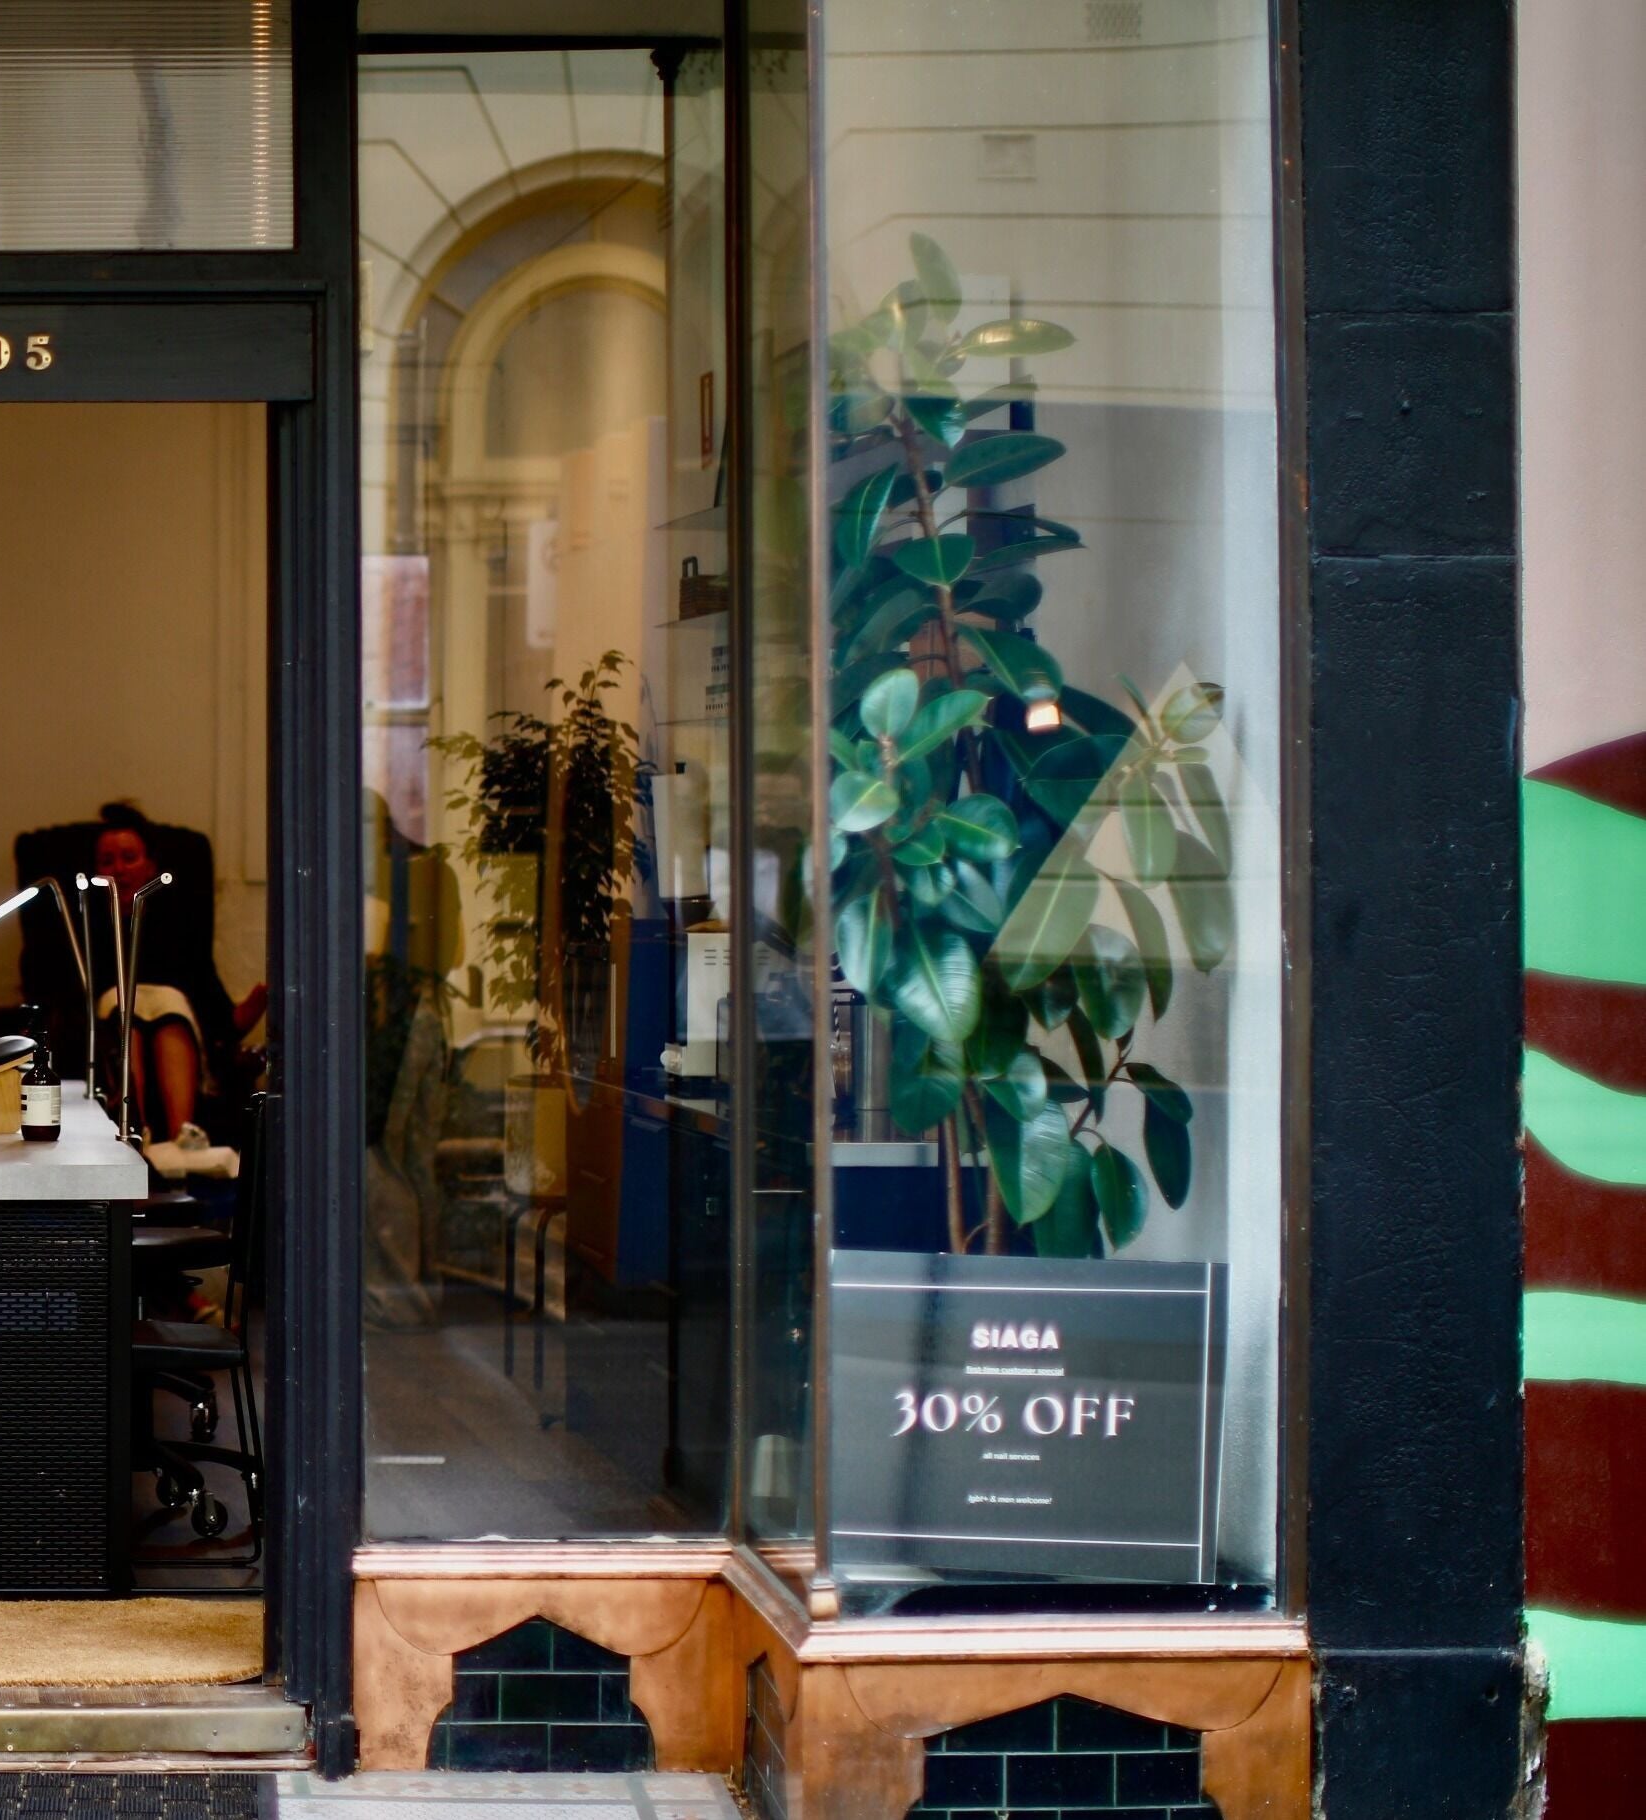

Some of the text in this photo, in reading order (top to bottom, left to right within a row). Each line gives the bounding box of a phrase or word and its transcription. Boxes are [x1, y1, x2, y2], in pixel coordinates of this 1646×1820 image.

[972, 1327, 1059, 1350] SIAGA
[890, 1391, 1136, 1438] 30% OFF
